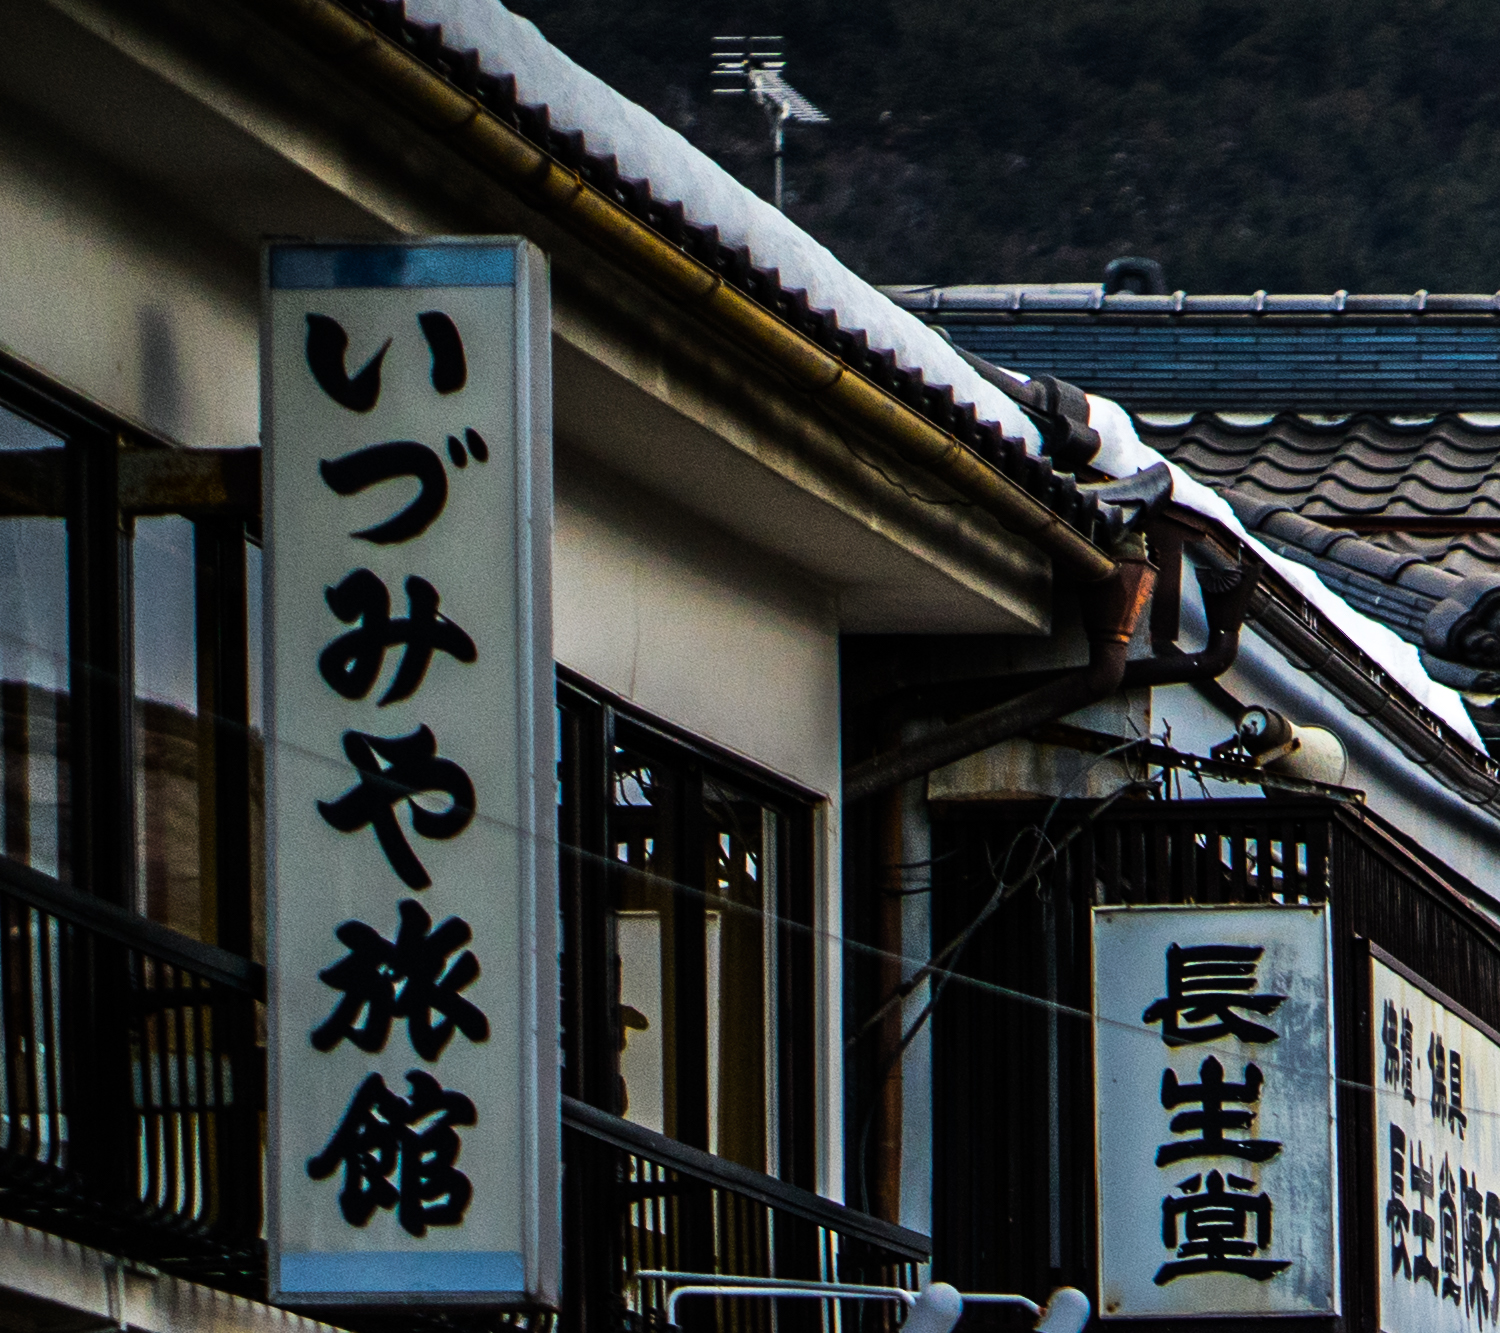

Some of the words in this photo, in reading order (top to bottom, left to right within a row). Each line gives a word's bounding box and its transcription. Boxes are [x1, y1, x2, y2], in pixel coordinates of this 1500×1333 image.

[307, 311, 489, 1237] いづみや旅館
[1143, 943, 1292, 1288] 長生堂
